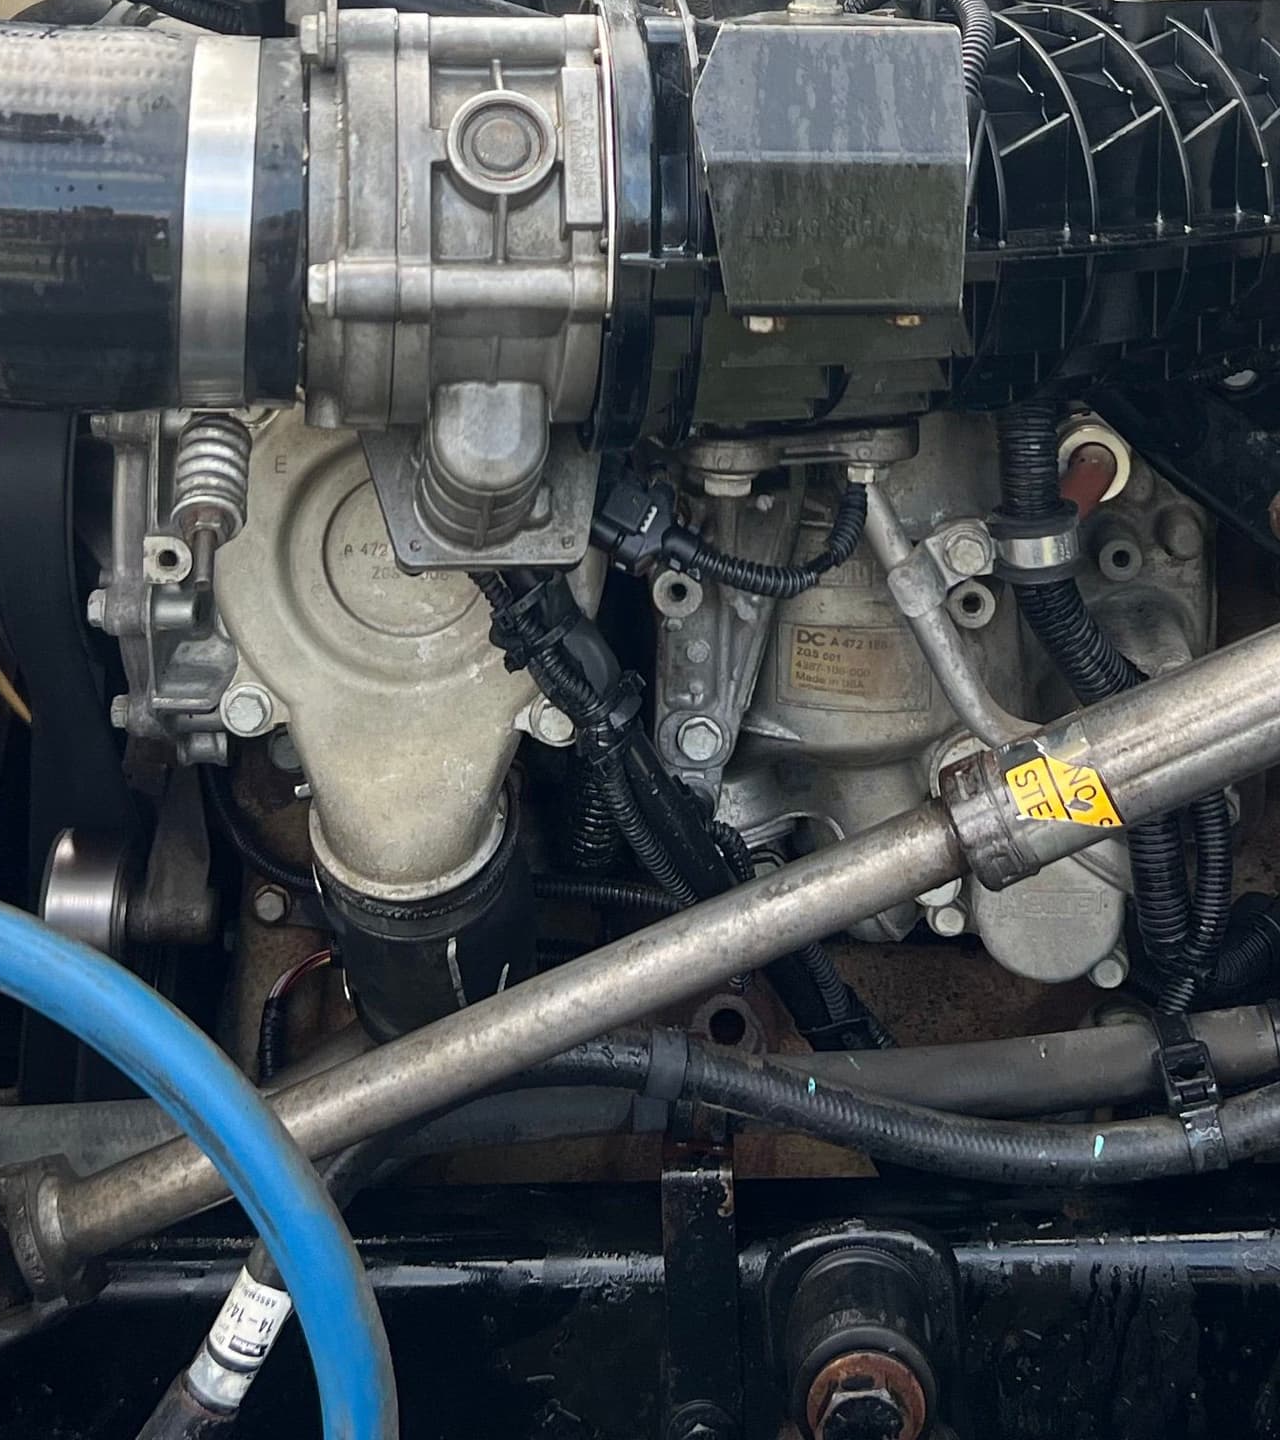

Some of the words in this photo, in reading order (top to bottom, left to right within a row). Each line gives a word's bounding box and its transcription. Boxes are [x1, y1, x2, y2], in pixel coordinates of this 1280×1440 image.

[797, 629, 825, 647] DC
[830, 637, 840, 648] A
[842, 639, 864, 650] 472
[795, 671, 826, 685] Made
[1014, 769, 1057, 819] STE
